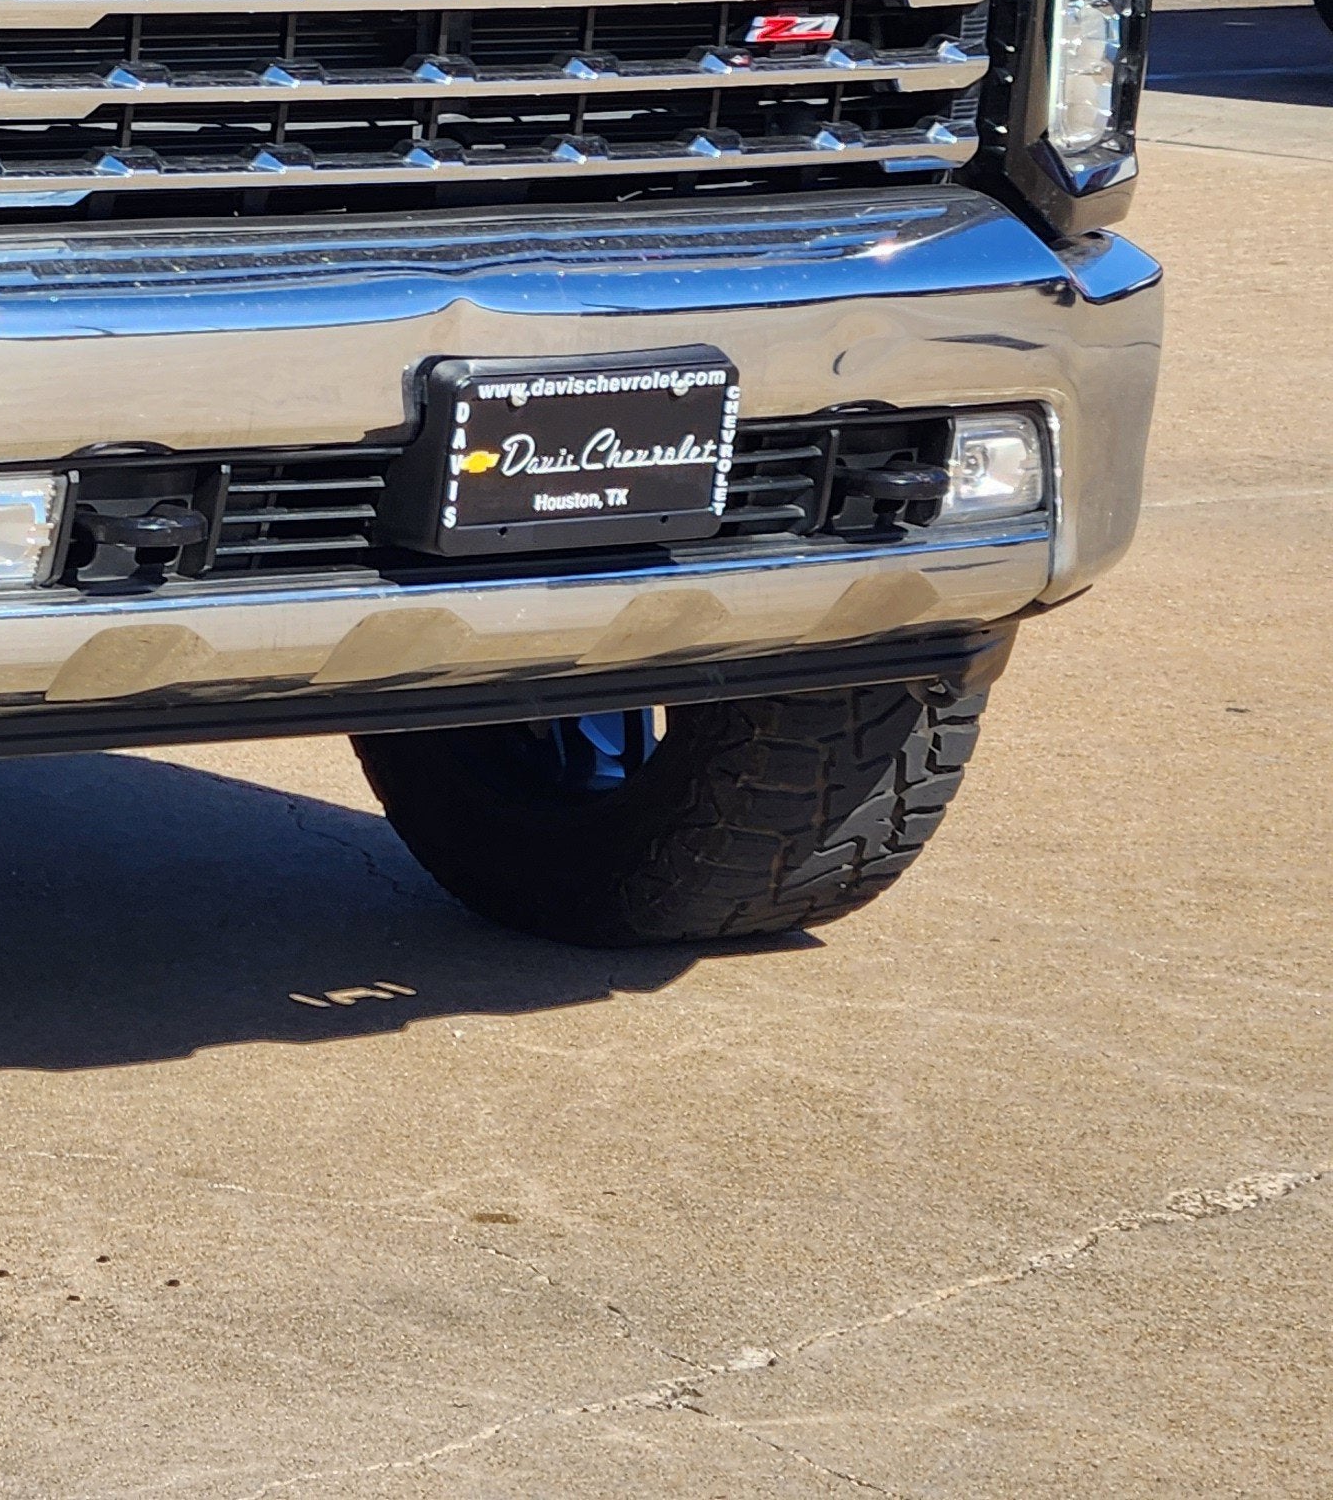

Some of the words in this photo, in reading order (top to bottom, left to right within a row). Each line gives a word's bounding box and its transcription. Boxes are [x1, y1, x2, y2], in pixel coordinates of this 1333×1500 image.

[478, 370, 726, 400] www.davischevrolet.com
[441, 401, 470, 529] DAVIS
[501, 433, 580, 477] Davis
[581, 427, 718, 471] Chevrolet
[713, 385, 740, 516] CHEVROLET
[534, 491, 604, 512] Houston,
[605, 488, 629, 507] TX
